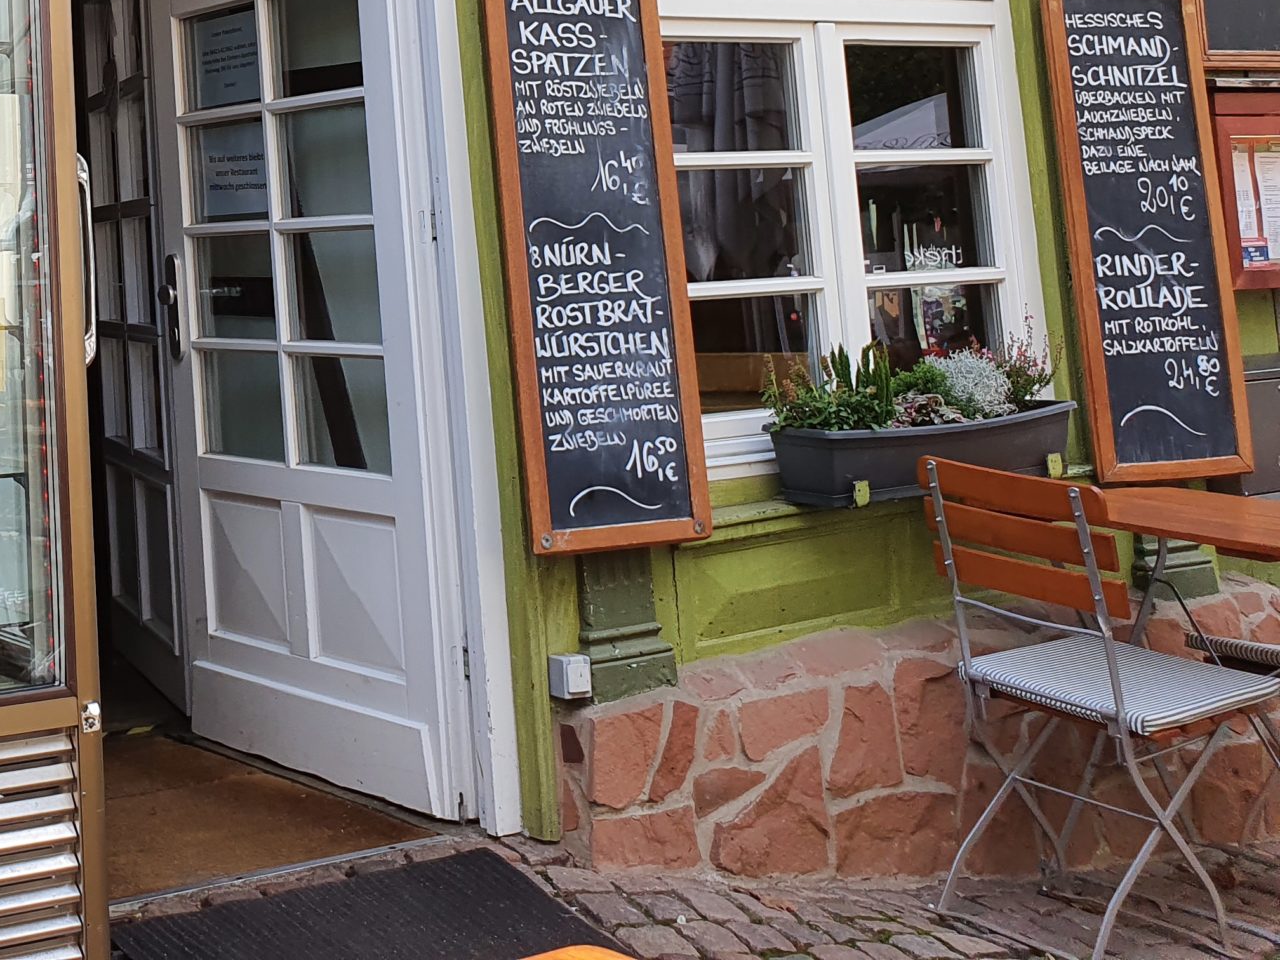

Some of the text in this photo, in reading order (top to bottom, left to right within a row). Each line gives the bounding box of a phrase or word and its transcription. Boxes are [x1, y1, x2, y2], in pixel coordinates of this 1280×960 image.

[1065, 11, 1164, 30] HESSISCHES
[519, 21, 608, 48] KASS-
[511, 44, 629, 77] SPATZEN
[1071, 65, 1188, 87] SCHNITZEL
[515, 78, 644, 103] MIT RÖSTZWIEBELN
[1161, 90, 1185, 104] MIT
[516, 100, 647, 119] AN ROTEN ZWIEBELN
[517, 118, 541, 145] UND
[519, 138, 585, 157] ZWIEBELN
[1081, 144, 1148, 158] DAZU EINE
[1082, 154, 1202, 177] BEILAGE NACH WAHL
[1095, 252, 1200, 288] RINDER-
[537, 269, 661, 301] BERGER
[1097, 284, 1208, 316] ROULADE
[536, 297, 664, 329] ROSTBRAT-
[1104, 320, 1131, 335] MIT
[535, 327, 670, 358] WÜRSTCHEN
[1103, 331, 1218, 356] SALZKARTOFFELN
[541, 358, 672, 384] MIT SAUERKRAUT
[545, 403, 679, 433] UND GESCHMORTEN
[548, 430, 627, 452] ZWIEBELN
